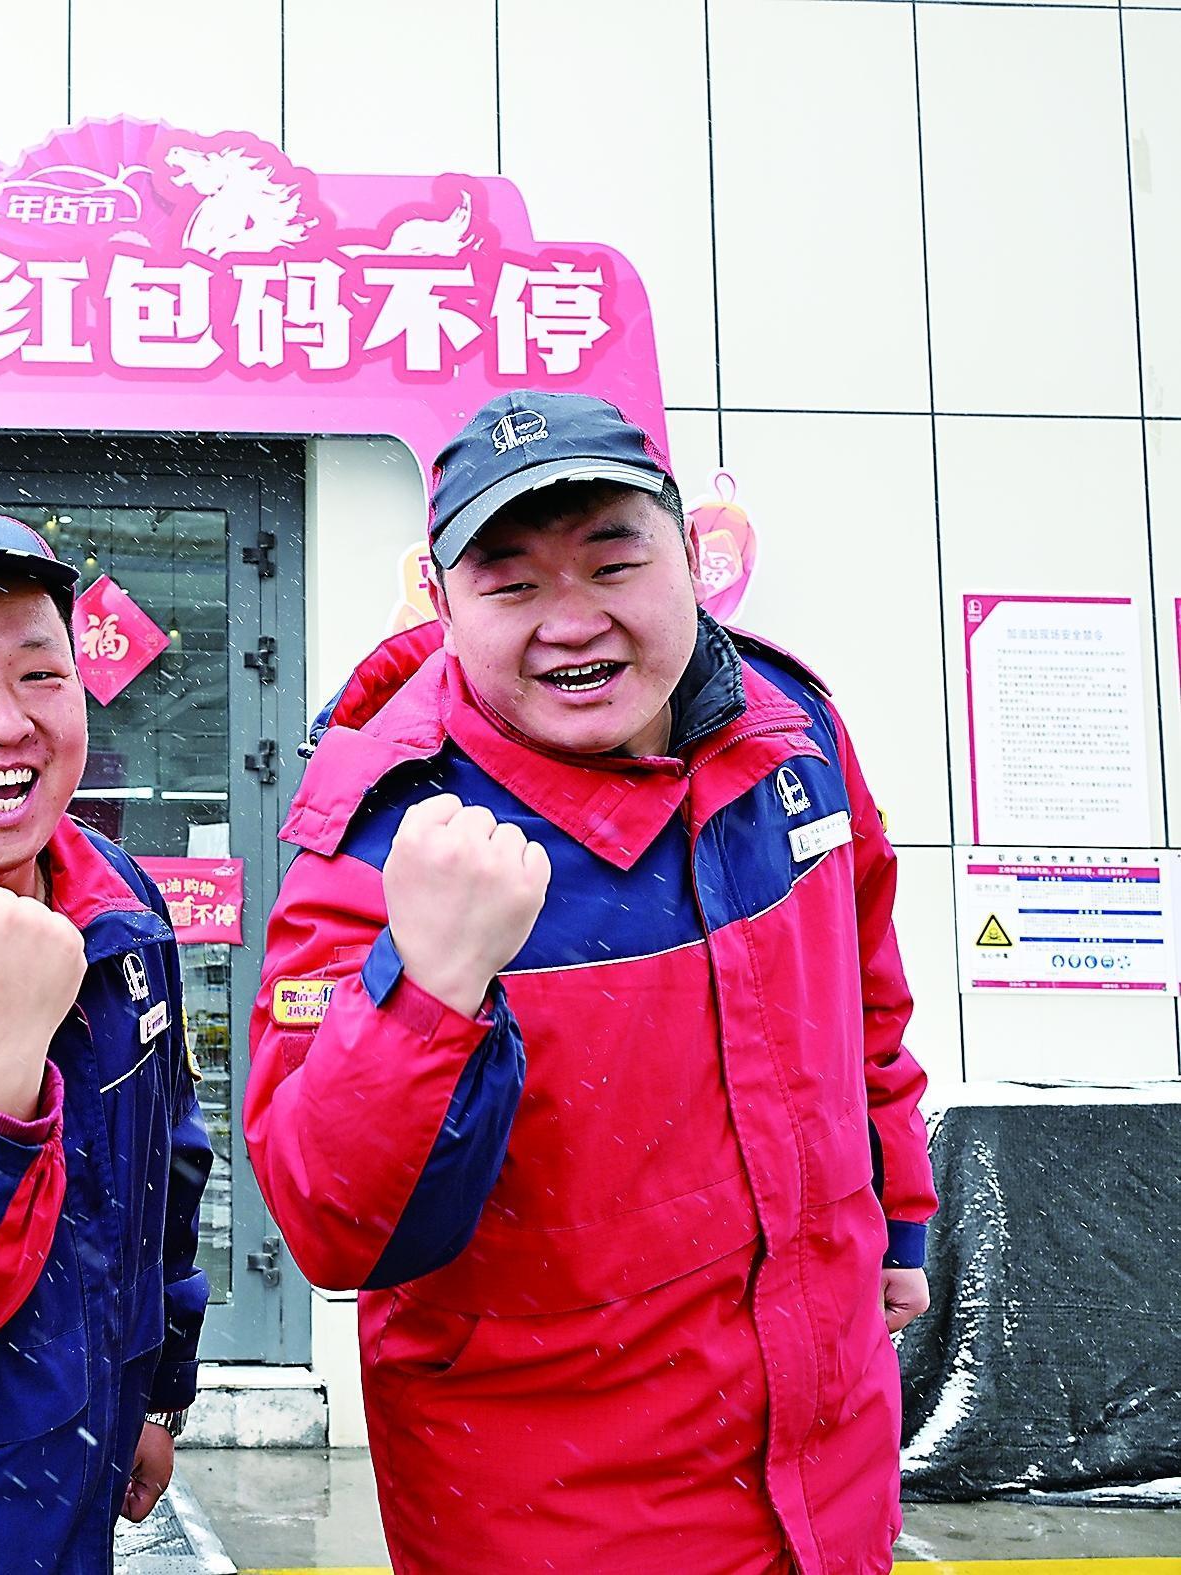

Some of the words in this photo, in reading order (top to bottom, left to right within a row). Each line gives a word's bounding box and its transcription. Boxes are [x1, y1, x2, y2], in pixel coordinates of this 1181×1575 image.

[6, 194, 117, 225] 年货节
[79, 613, 130, 661] 福
[193, 903, 237, 928] 不停
